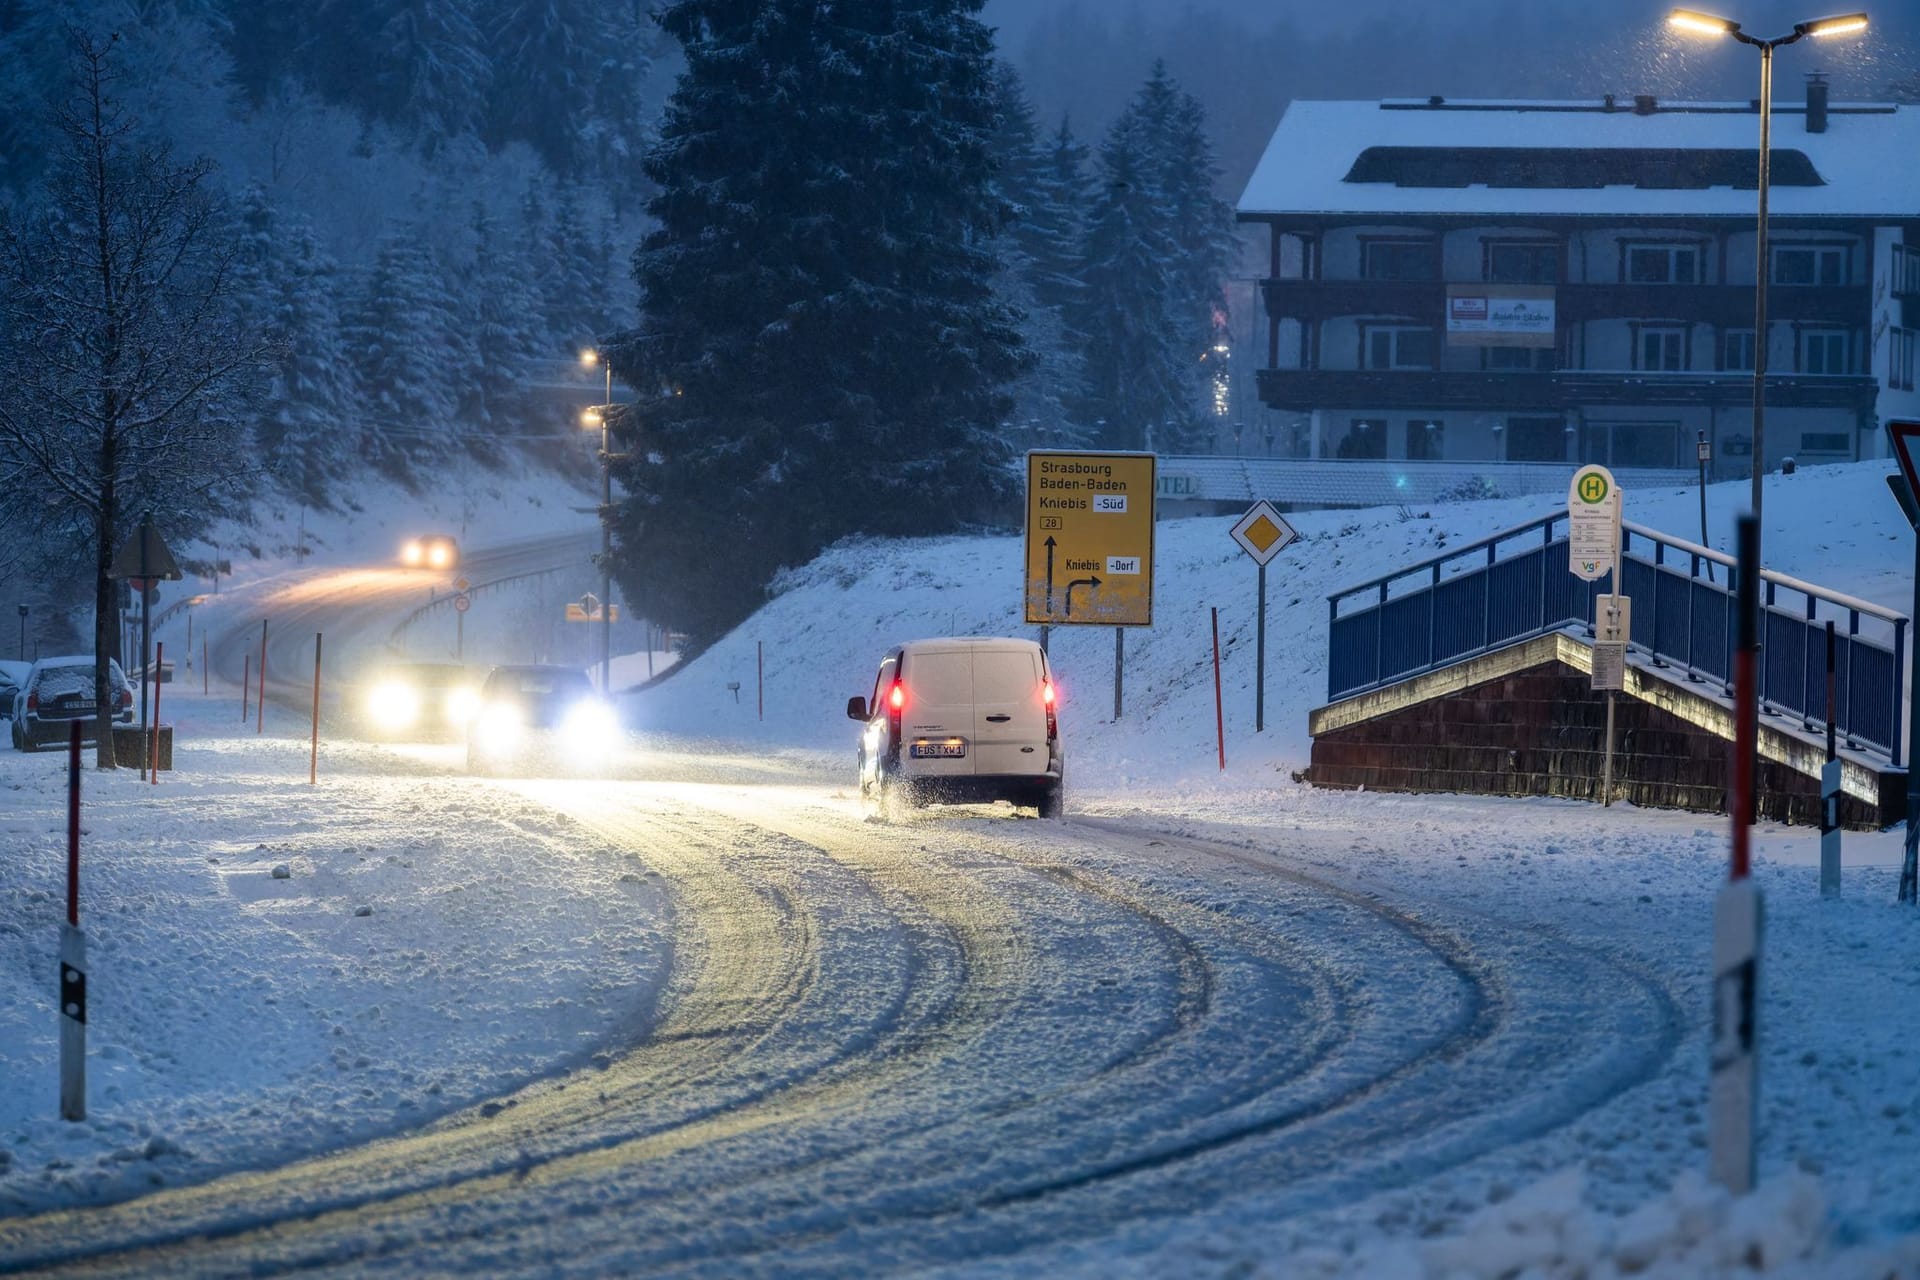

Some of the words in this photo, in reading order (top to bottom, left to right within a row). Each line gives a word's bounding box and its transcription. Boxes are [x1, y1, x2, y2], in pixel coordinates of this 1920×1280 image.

[1041, 461, 1112, 476] Strasbourg
[1040, 477, 1127, 490] Baden-Baden
[1156, 476, 1196, 495] TEL
[1586, 480, 1600, 496] H
[1040, 496, 1087, 509] Kniebis
[1096, 498, 1124, 509] -Süd
[1045, 518, 1057, 528] 28
[1065, 559, 1100, 571] Kniebis
[1110, 560, 1135, 571] -Dorf
[918, 745, 936, 755] FDS
